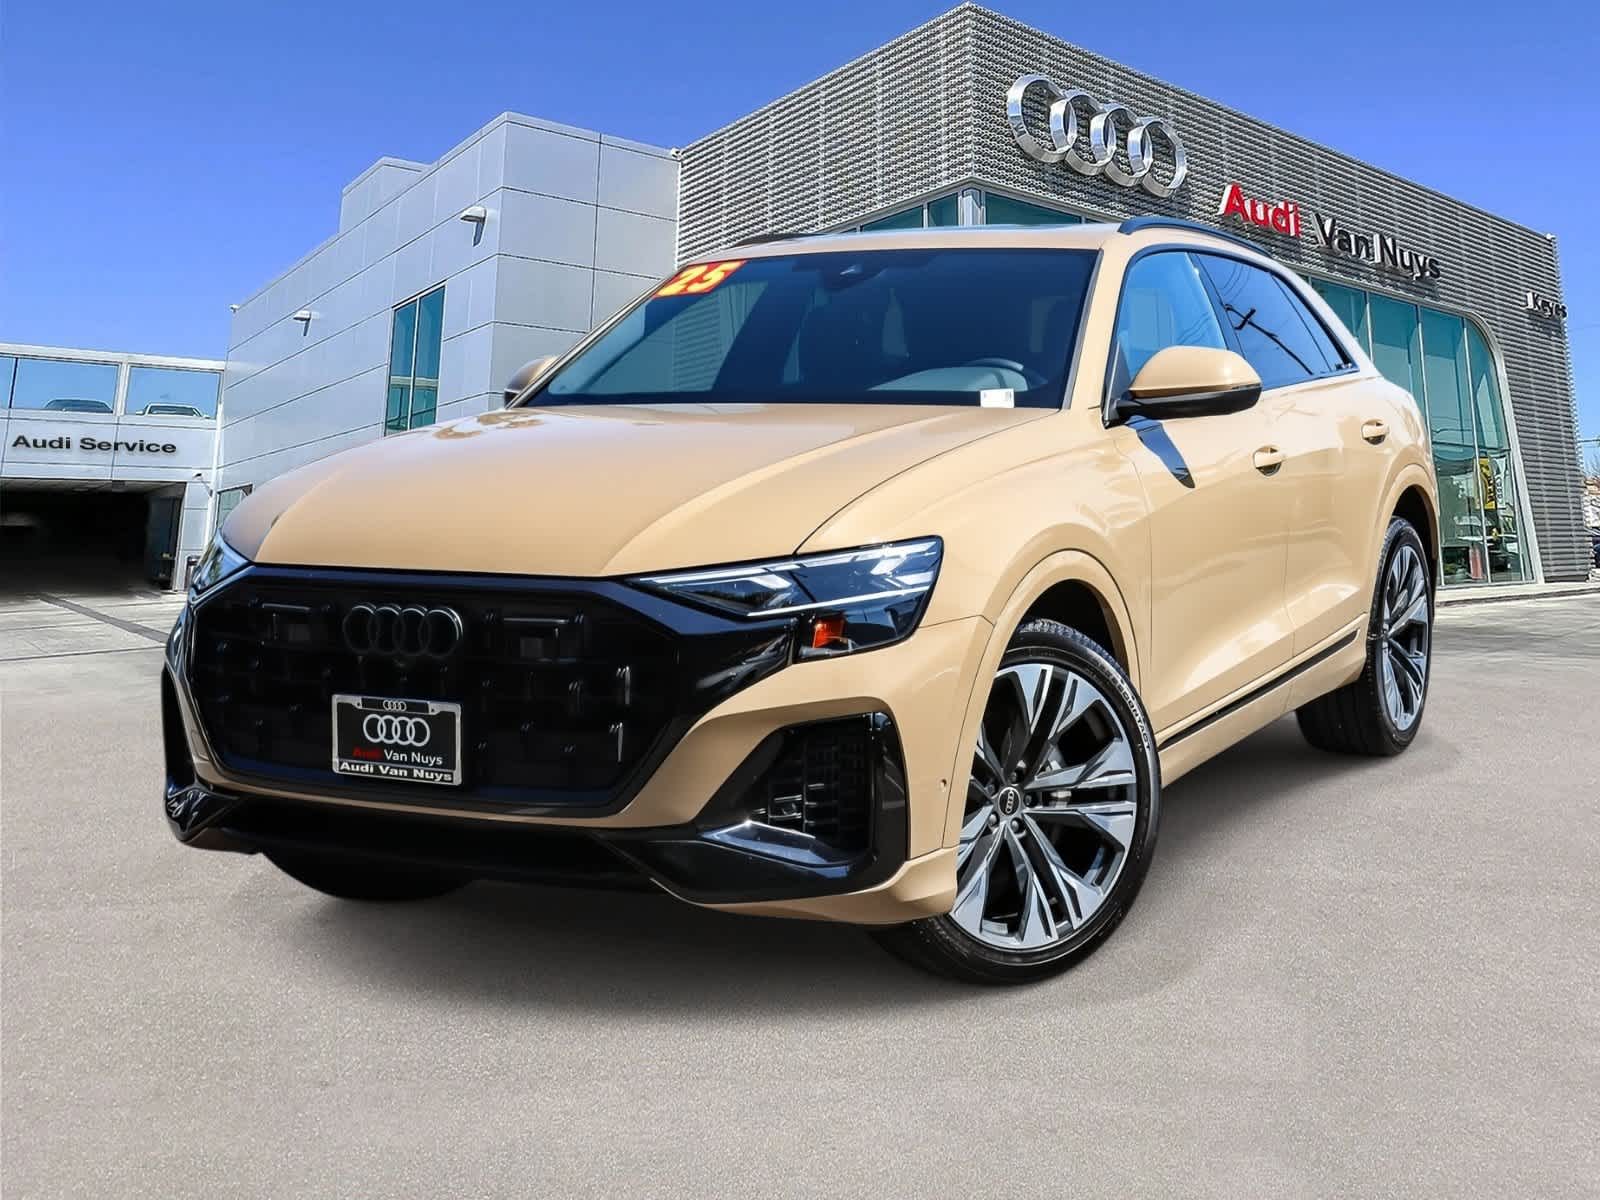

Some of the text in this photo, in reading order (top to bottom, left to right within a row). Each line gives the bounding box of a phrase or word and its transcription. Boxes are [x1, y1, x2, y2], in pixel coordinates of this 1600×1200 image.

[1218, 183, 1441, 280] Audi Van Nuys
[657, 260, 742, 296] 25
[12, 435, 177, 453] Audi Service
[384, 749, 408, 762] Van
[411, 752, 443, 766] Nuys
[340, 761, 452, 782] Audi Van Nuys
